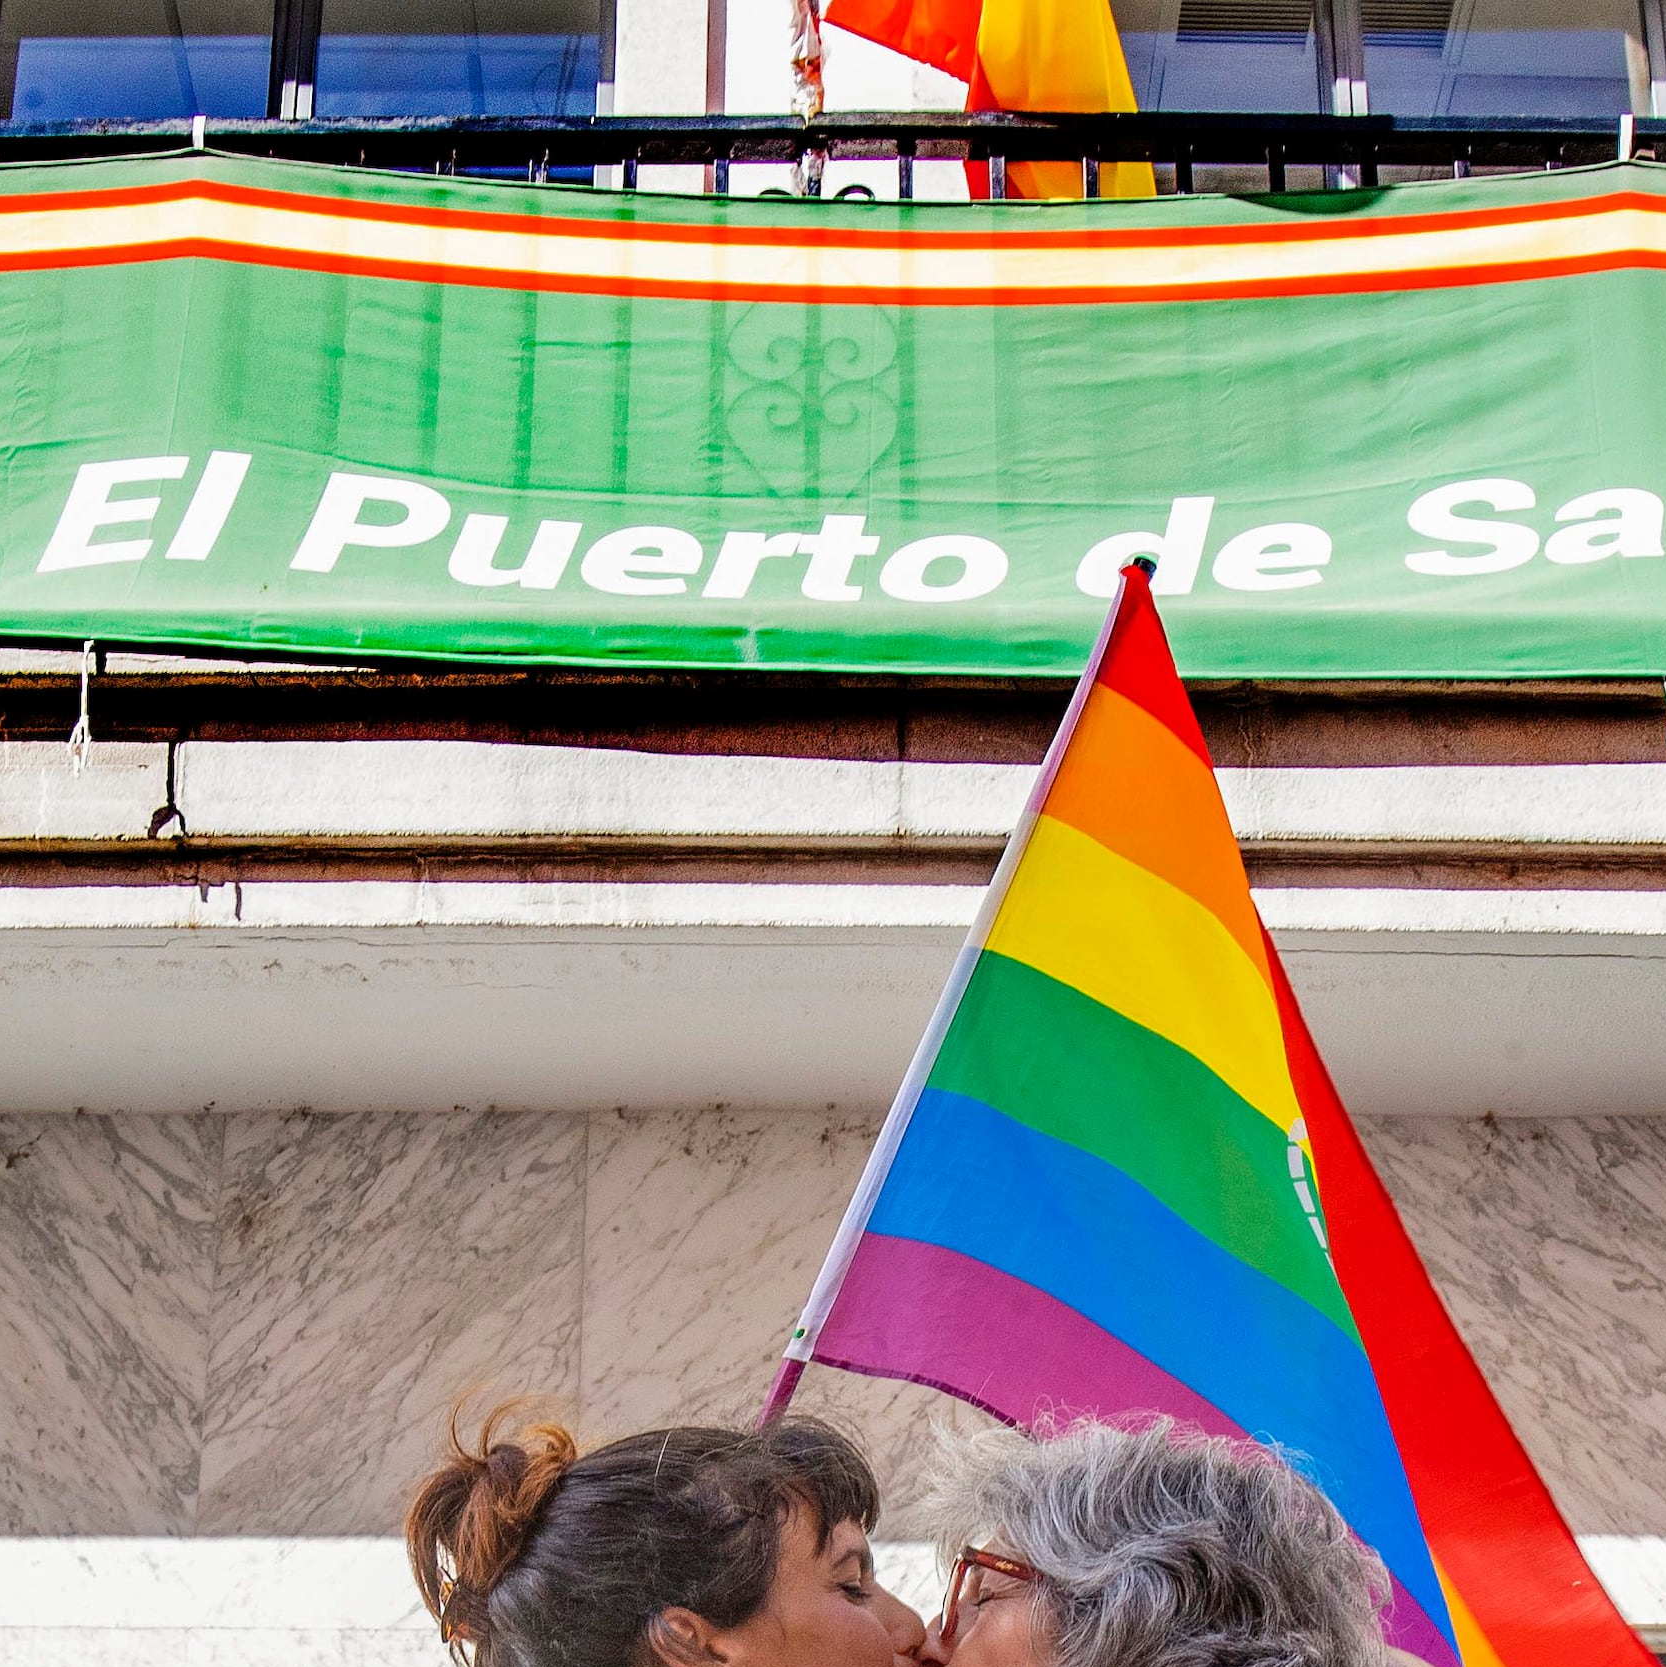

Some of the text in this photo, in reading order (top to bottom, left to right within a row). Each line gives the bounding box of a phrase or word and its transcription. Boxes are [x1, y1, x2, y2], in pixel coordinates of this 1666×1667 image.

[36, 451, 252, 575] El
[290, 472, 1010, 603] Puerto
[1075, 496, 1333, 598] de
